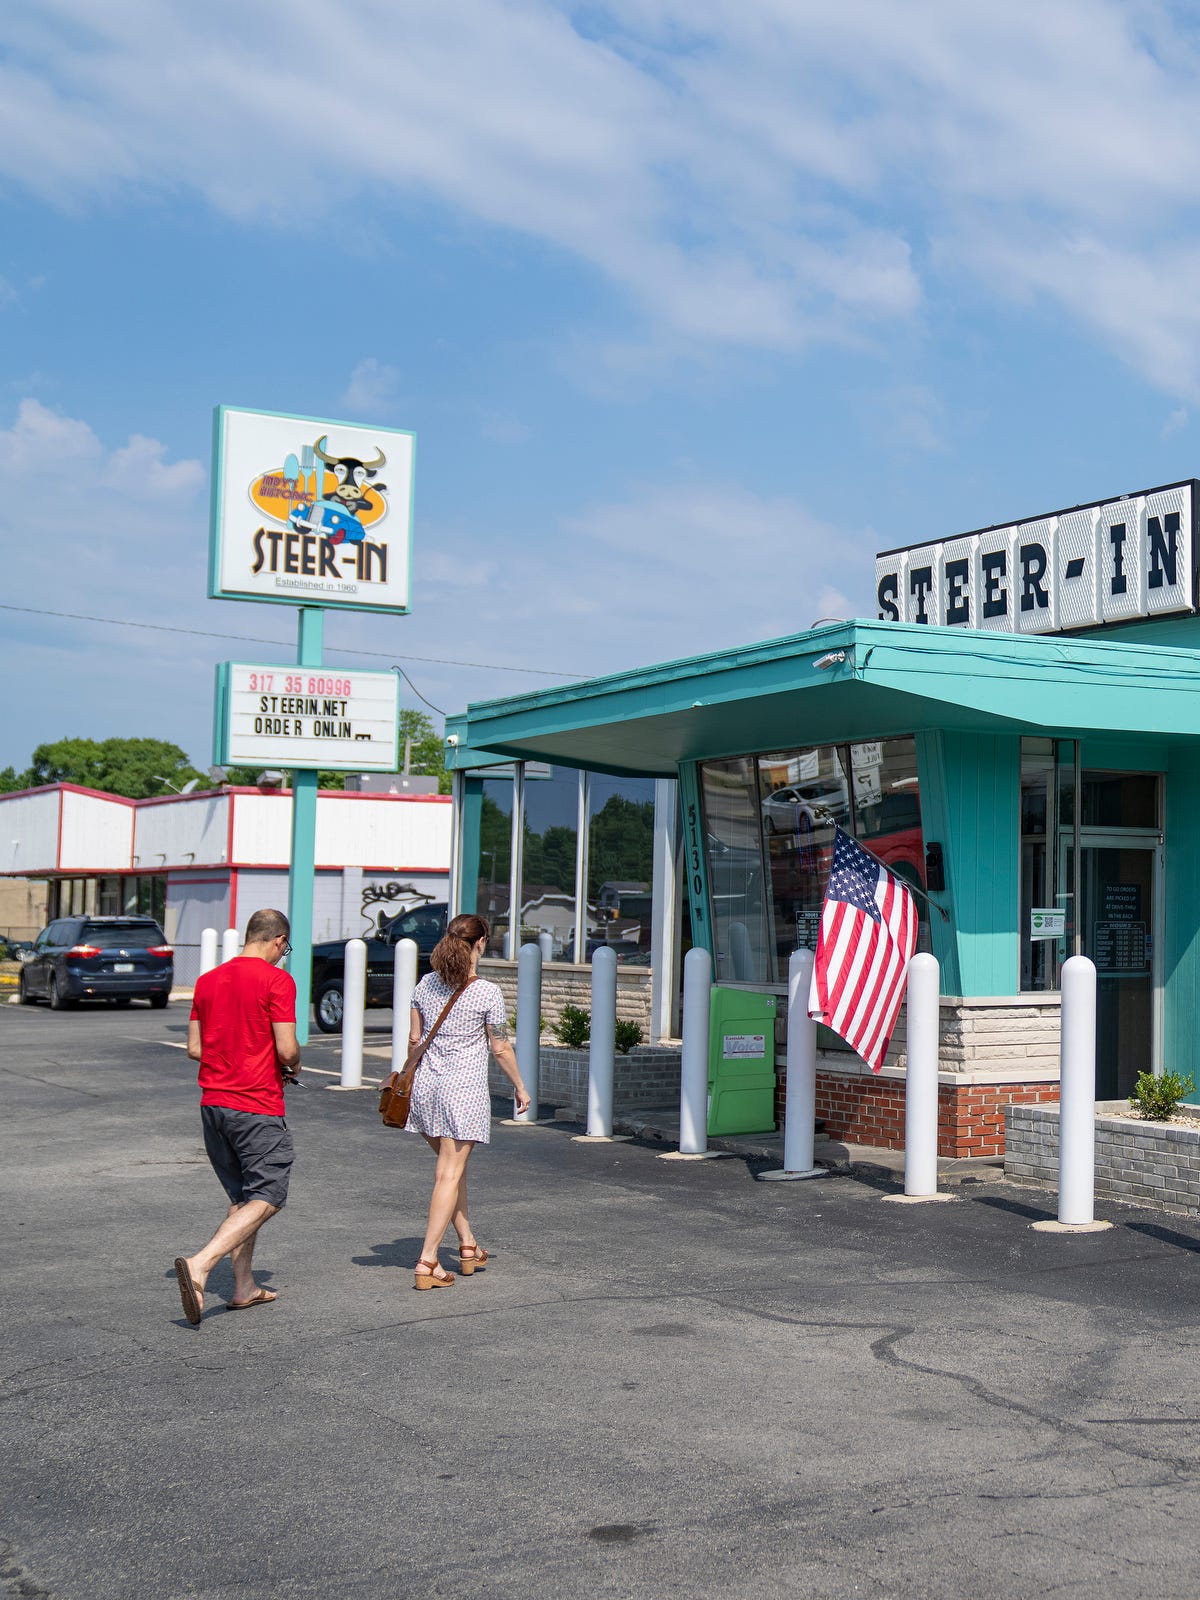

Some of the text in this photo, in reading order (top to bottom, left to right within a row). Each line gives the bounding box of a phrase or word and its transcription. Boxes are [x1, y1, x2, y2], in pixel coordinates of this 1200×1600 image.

[259, 486, 314, 502] HISTORIC
[252, 527, 388, 582] STEER-IN
[878, 511, 1181, 626] STEER-IN
[275, 577, 357, 592] Established in 1960
[249, 673, 274, 692] 317
[260, 695, 348, 717] STEERIN.NET
[254, 717, 303, 737] ORDER
